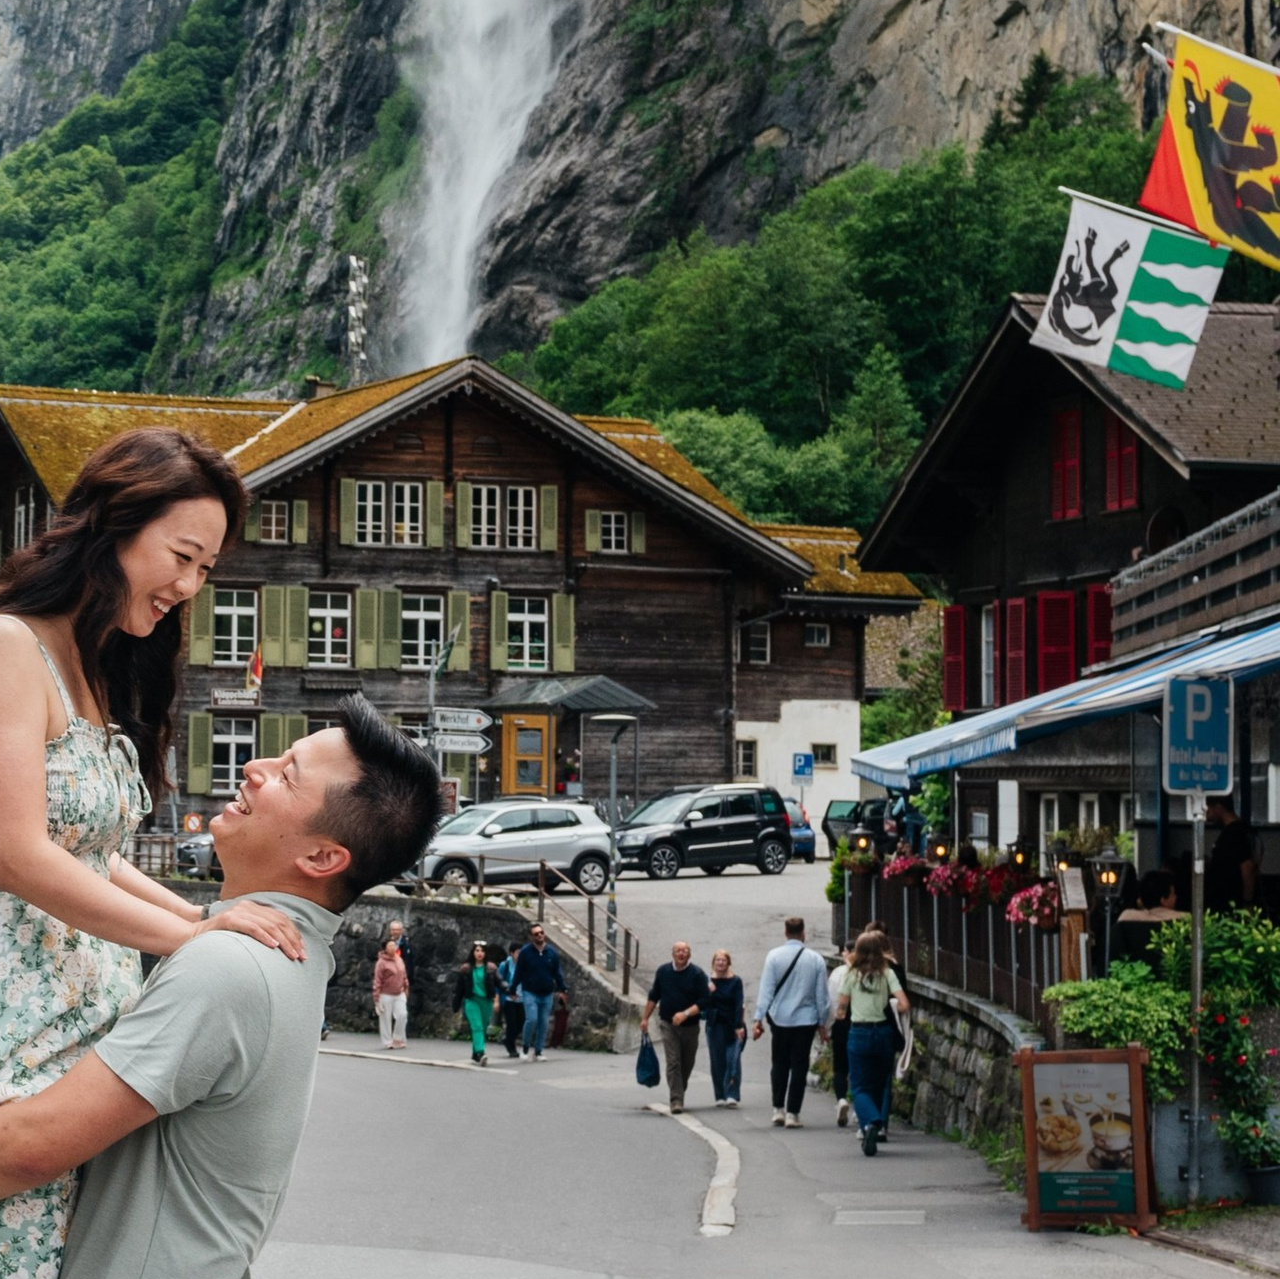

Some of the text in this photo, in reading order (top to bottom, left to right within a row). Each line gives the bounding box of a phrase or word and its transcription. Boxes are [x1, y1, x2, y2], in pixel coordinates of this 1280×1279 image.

[1185, 684, 1212, 740] P
[449, 738, 479, 749] Recycling
[795, 755, 805, 771] P
